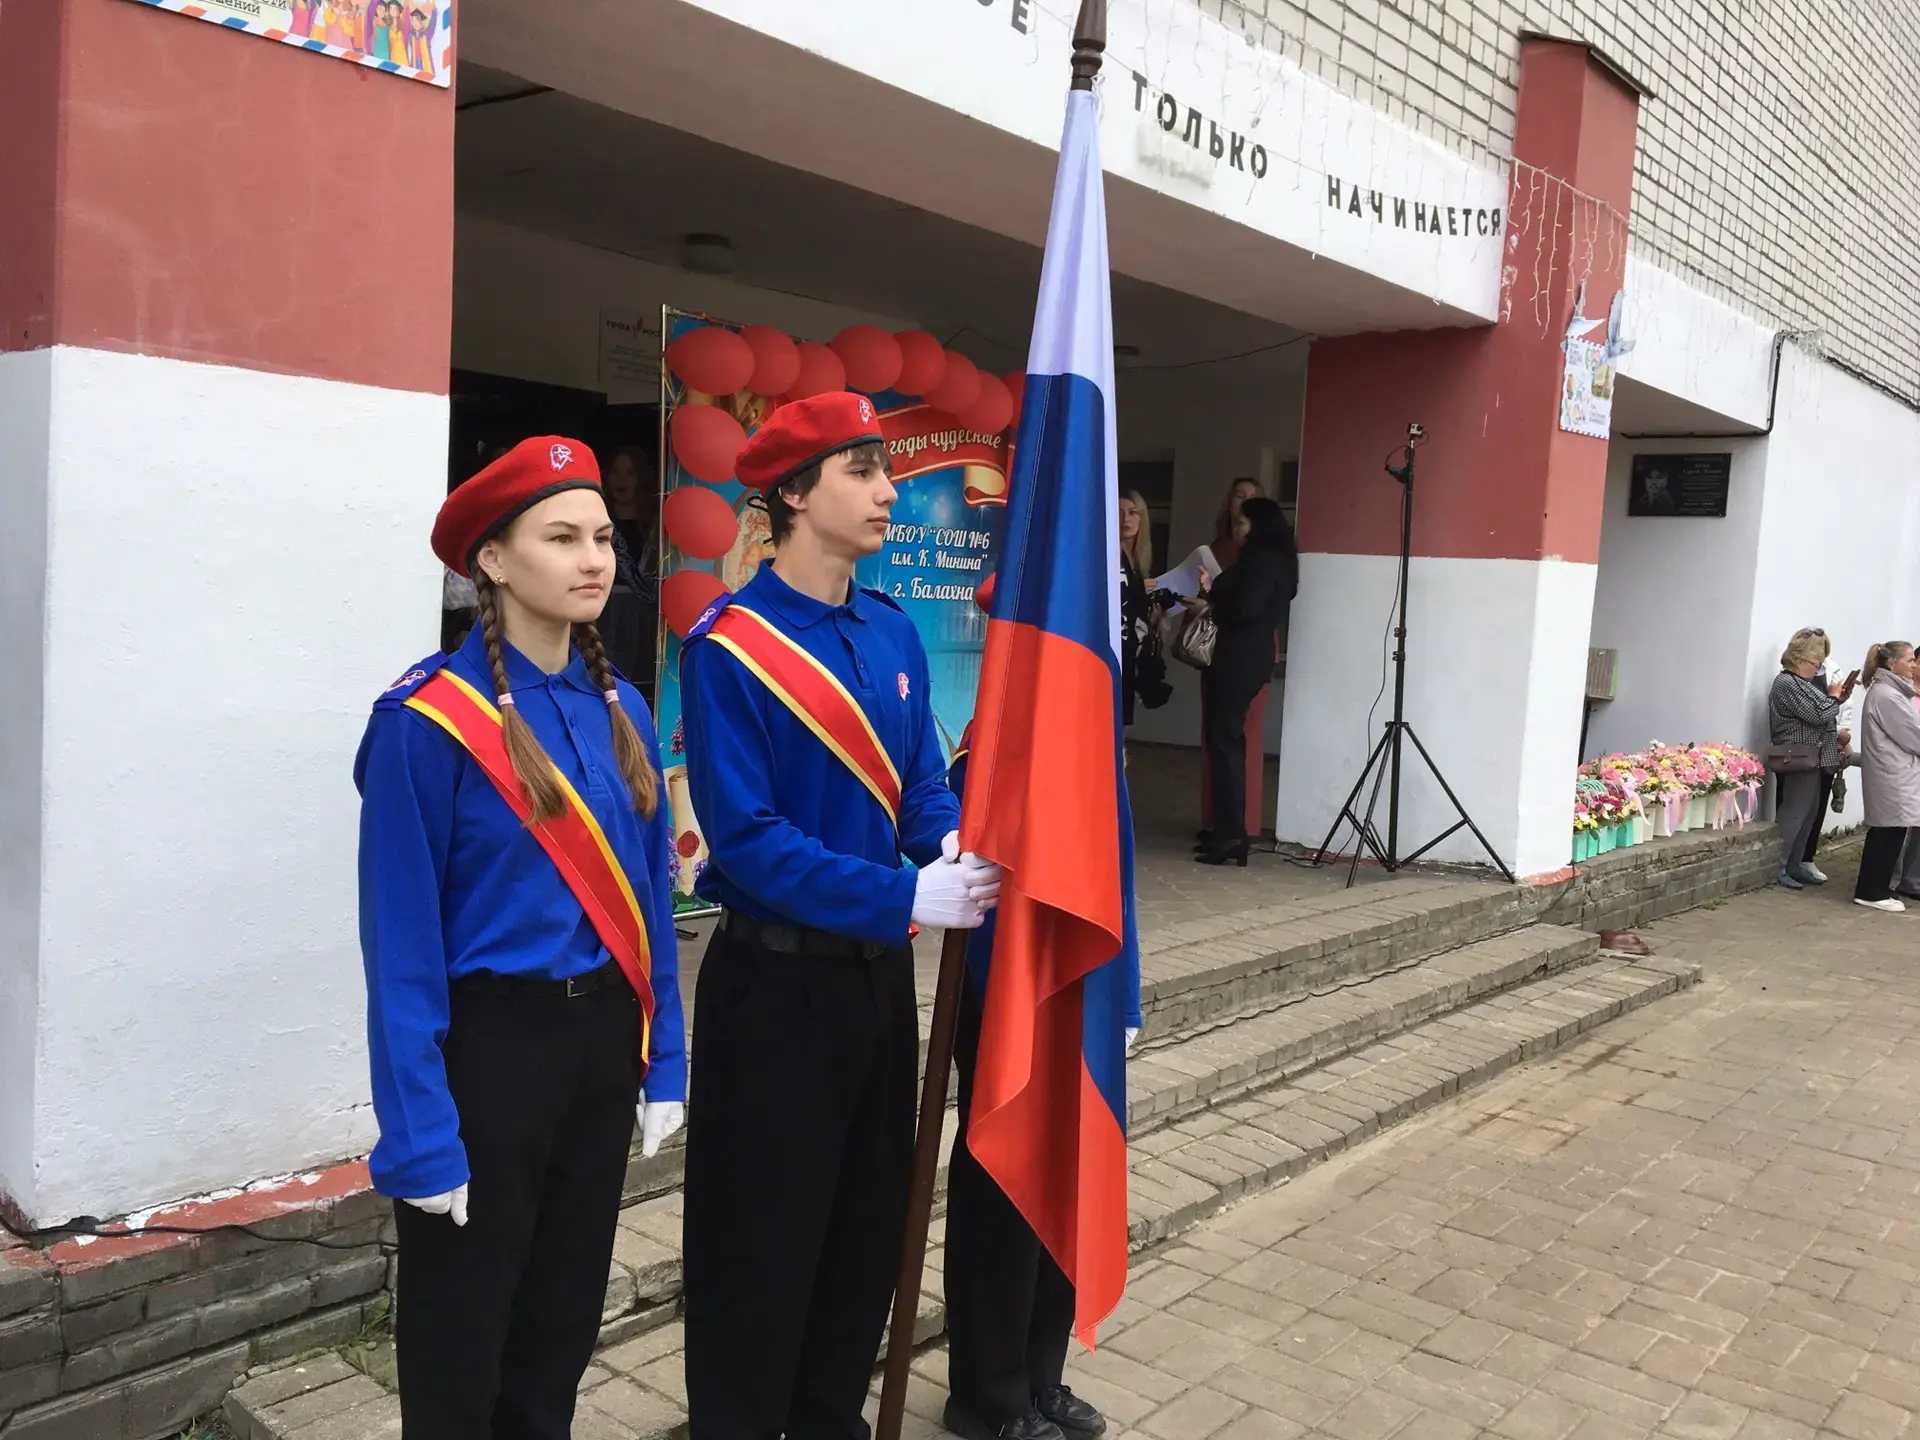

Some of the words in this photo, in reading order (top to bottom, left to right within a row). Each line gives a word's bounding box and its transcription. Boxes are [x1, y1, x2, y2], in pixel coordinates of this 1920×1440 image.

[1132, 70, 1267, 179] ТОЛЬКО
[1327, 174, 1501, 236] НАЧИНАЕТСЯ
[889, 434, 928, 458] годы
[930, 429, 1001, 451] чудесные
[883, 523, 927, 544] МБОУ
[968, 531, 990, 549] №6
[891, 551, 914, 566] им.
[918, 548, 930, 567] К.
[894, 582, 906, 598] г.
[911, 577, 974, 600] Балахна
